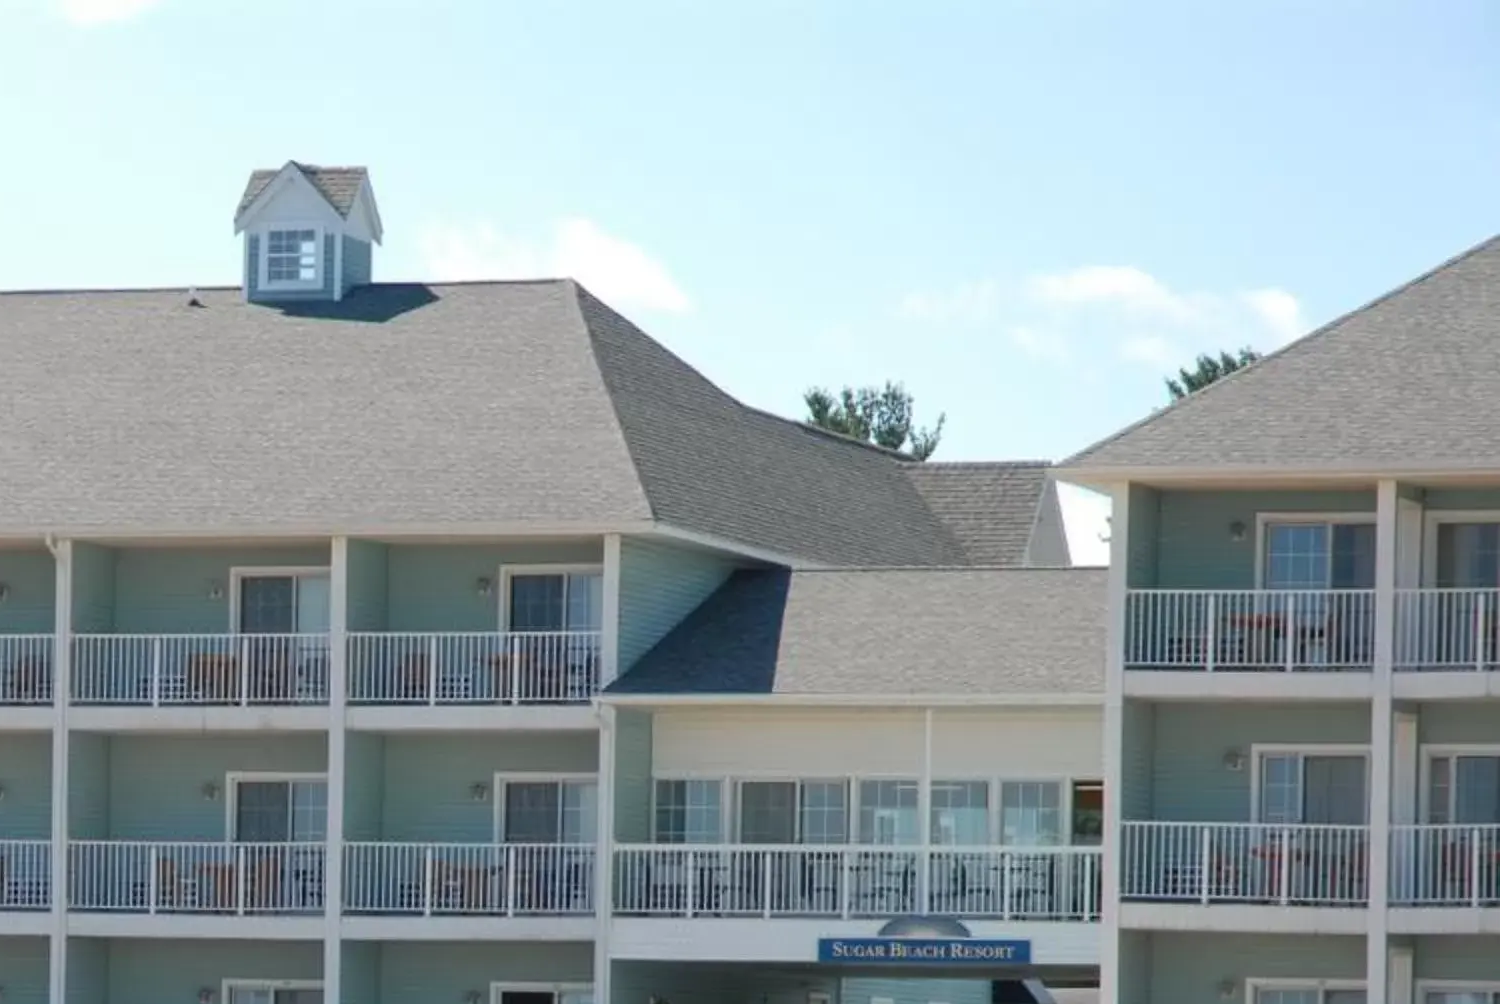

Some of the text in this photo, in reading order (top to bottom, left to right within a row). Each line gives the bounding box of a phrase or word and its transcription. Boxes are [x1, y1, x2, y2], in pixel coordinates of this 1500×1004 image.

[832, 941, 1015, 959] SUGAR BEACH RESORT
